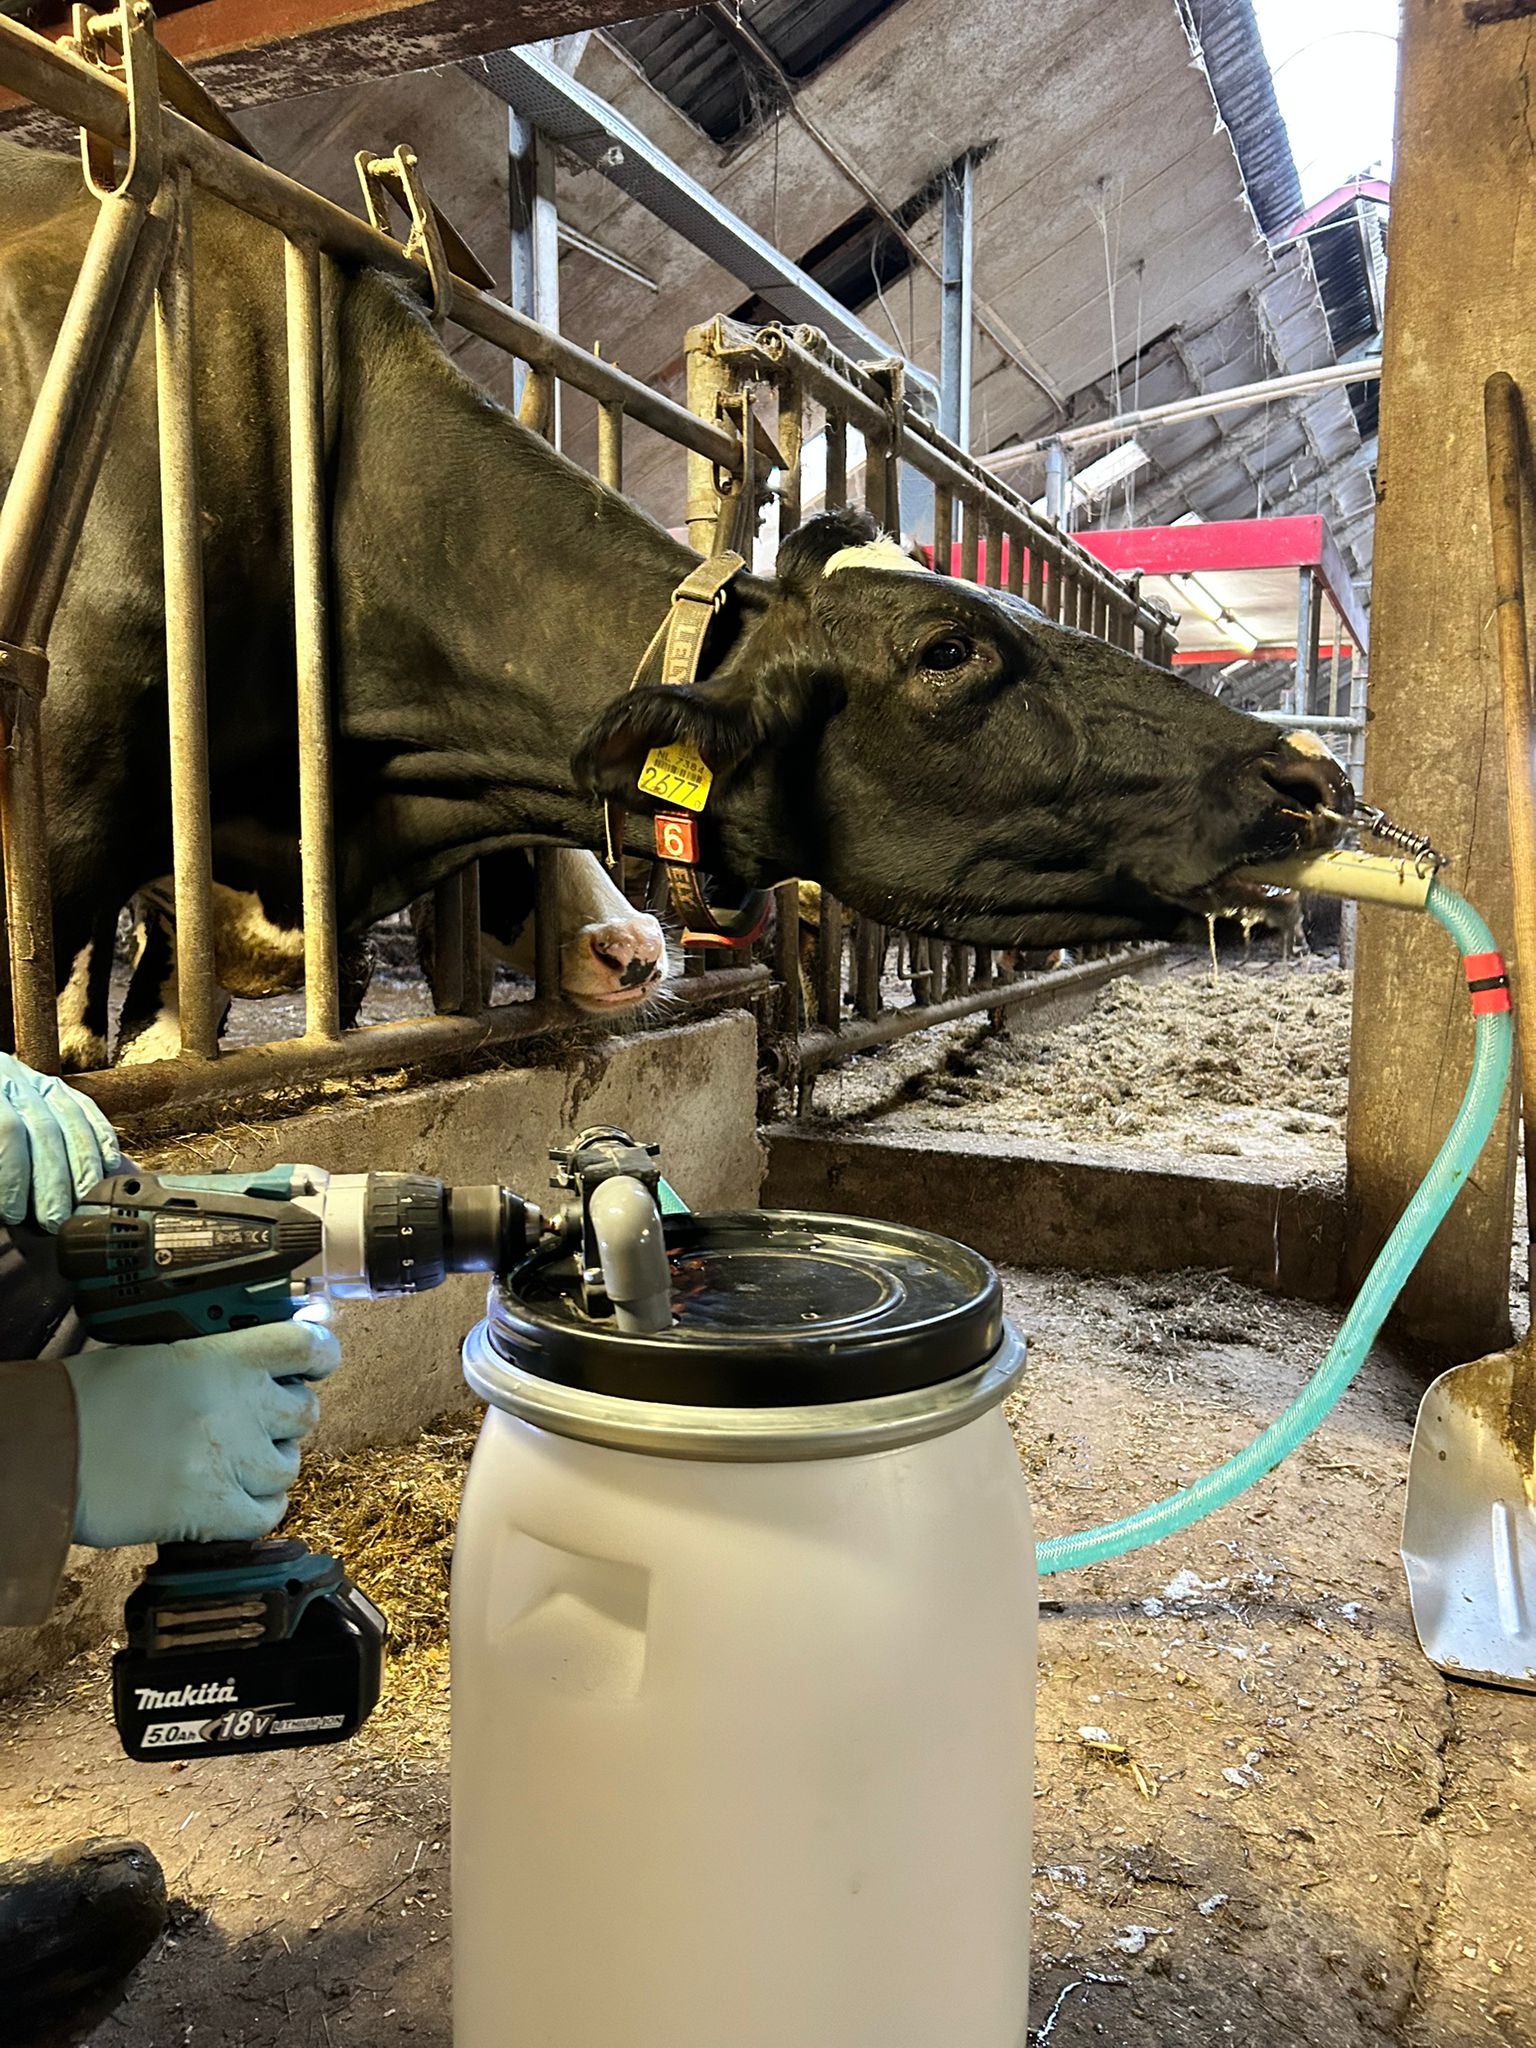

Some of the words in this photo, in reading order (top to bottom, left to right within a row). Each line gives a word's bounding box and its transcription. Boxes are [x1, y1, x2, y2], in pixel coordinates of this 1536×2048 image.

[657, 750, 671, 763] NL
[641, 767, 699, 804] 2677
[663, 822, 685, 857] 6
[671, 867, 697, 908] ELY
[400, 1226, 413, 1235] 3
[147, 1726, 197, 1746] 5.0Ah
[220, 1711, 271, 1740] 18V
